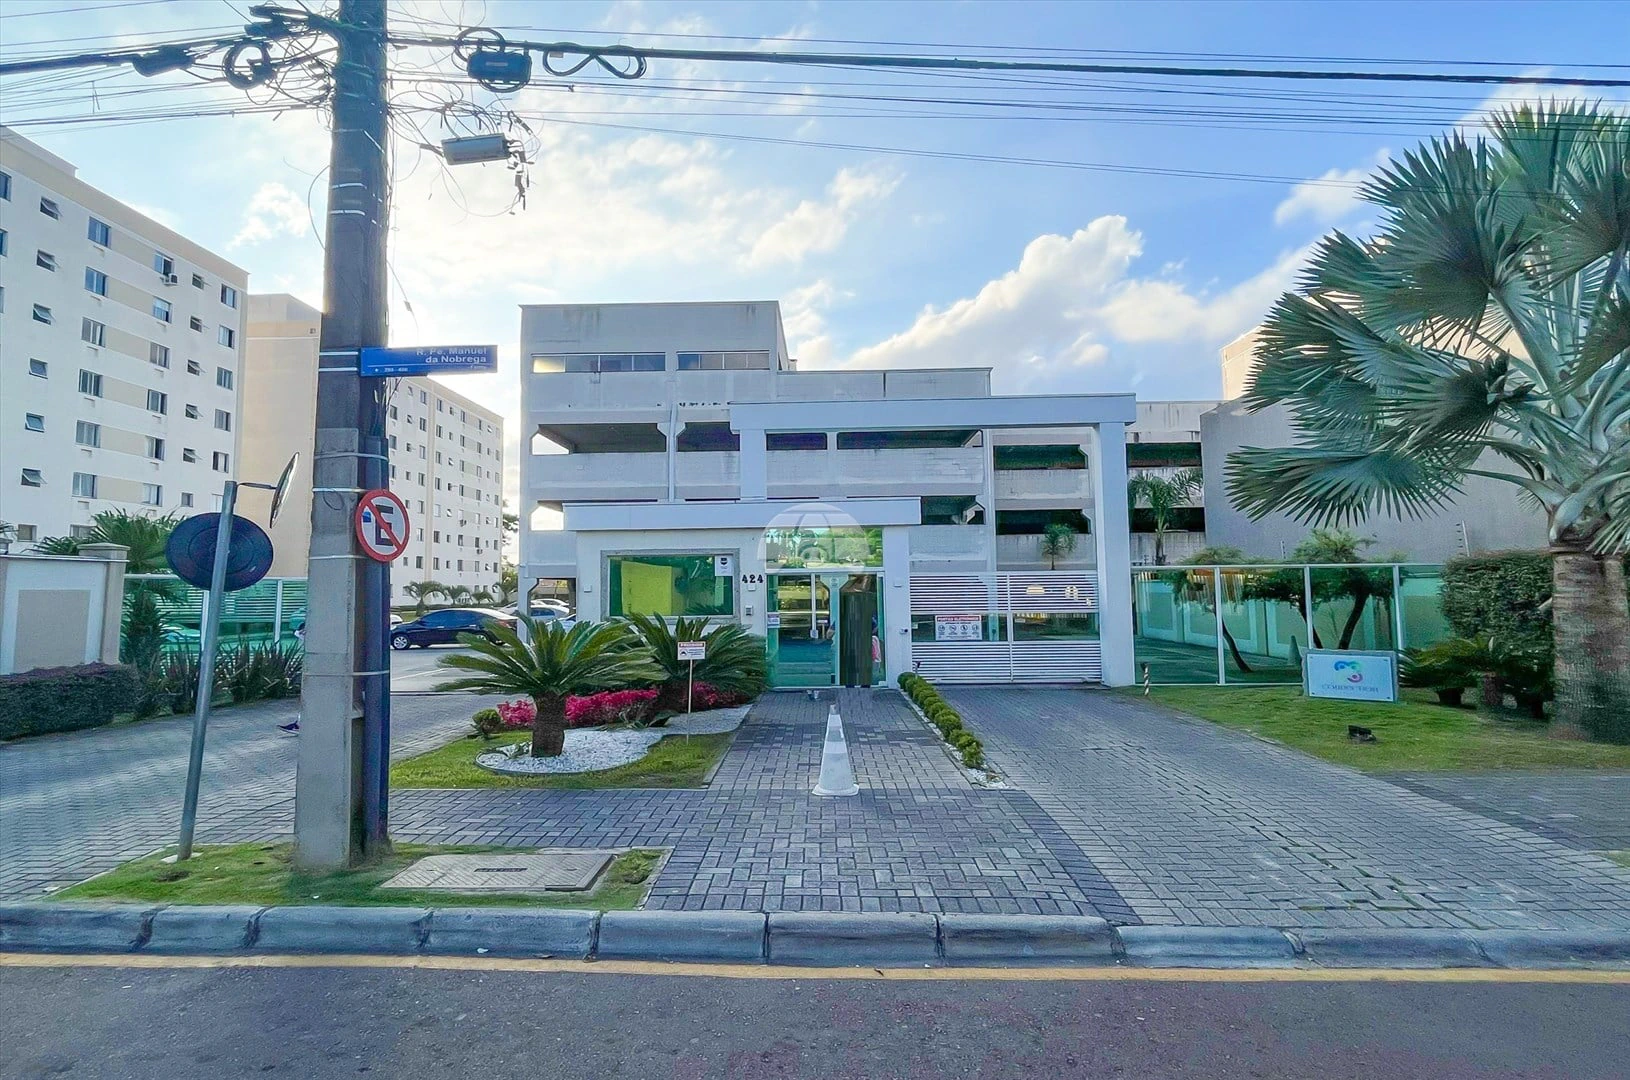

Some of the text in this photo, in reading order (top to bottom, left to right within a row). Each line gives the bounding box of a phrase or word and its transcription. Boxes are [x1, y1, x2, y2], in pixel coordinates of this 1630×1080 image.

[416, 347, 487, 356] R. Pe. Manuel
[425, 355, 487, 364] da Nobrega
[375, 504, 394, 546] E
[741, 574, 763, 584] 424
